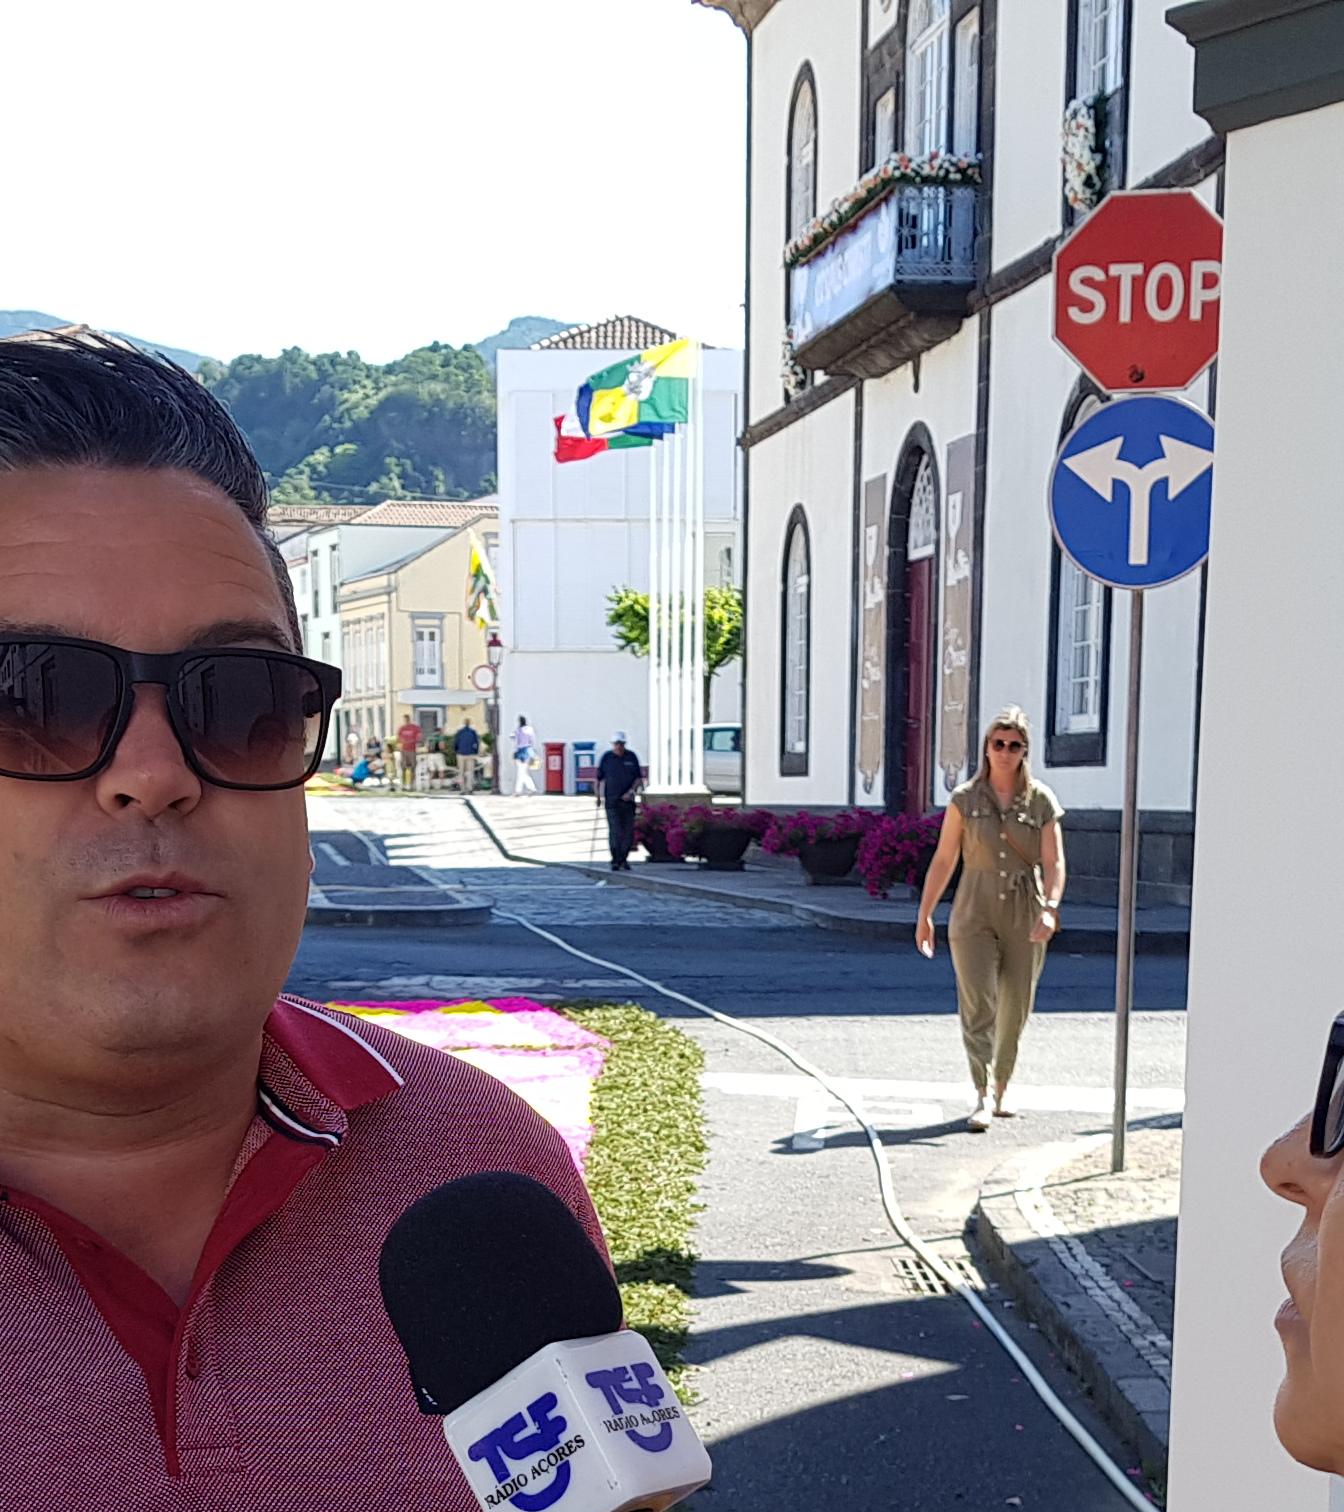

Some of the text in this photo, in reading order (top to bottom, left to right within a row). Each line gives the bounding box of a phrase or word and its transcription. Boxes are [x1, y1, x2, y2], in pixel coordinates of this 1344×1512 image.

[1067, 260, 1221, 324] STOP
[484, 1434, 586, 1510] RÁDIO AÇORES
